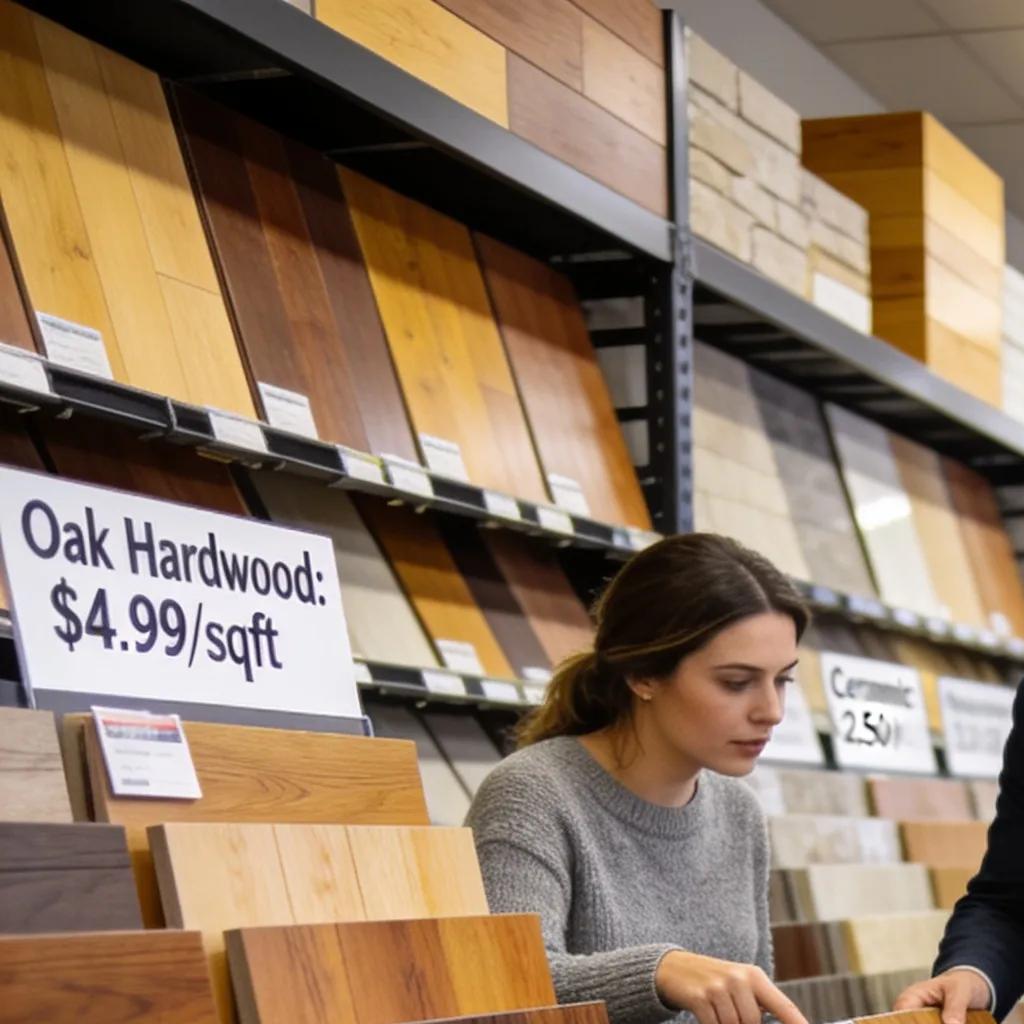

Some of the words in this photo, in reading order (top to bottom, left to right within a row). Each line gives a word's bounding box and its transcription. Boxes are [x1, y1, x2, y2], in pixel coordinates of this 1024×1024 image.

[21, 499, 115, 570] Oak
[123, 516, 327, 606] Hardwood:
[50, 577, 283, 683] $4.99/sqft
